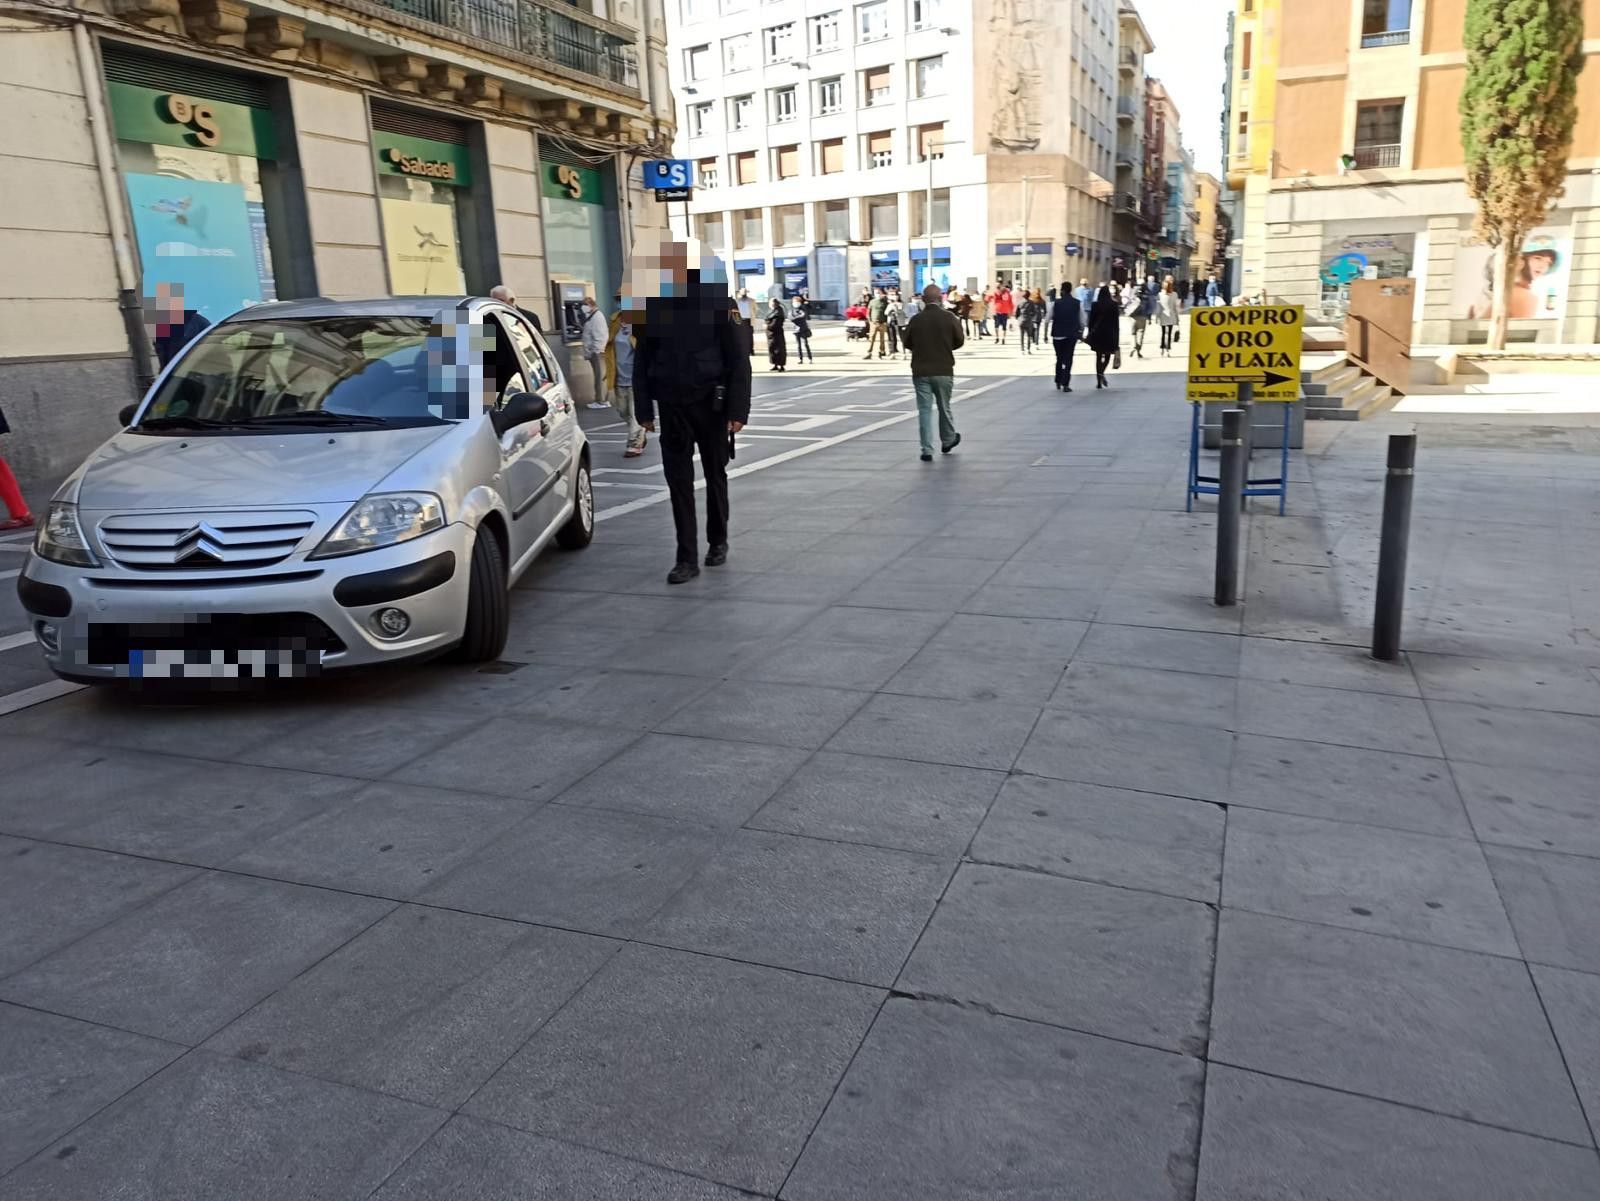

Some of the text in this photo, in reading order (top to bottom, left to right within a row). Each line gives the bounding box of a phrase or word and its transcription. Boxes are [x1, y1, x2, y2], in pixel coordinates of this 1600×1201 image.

[558, 164, 582, 199] S
[1195, 308, 1298, 327] COMPRO
[1216, 330, 1274, 348] ORO
[1196, 353, 1210, 368] Y
[1219, 352, 1294, 368] PLATA
